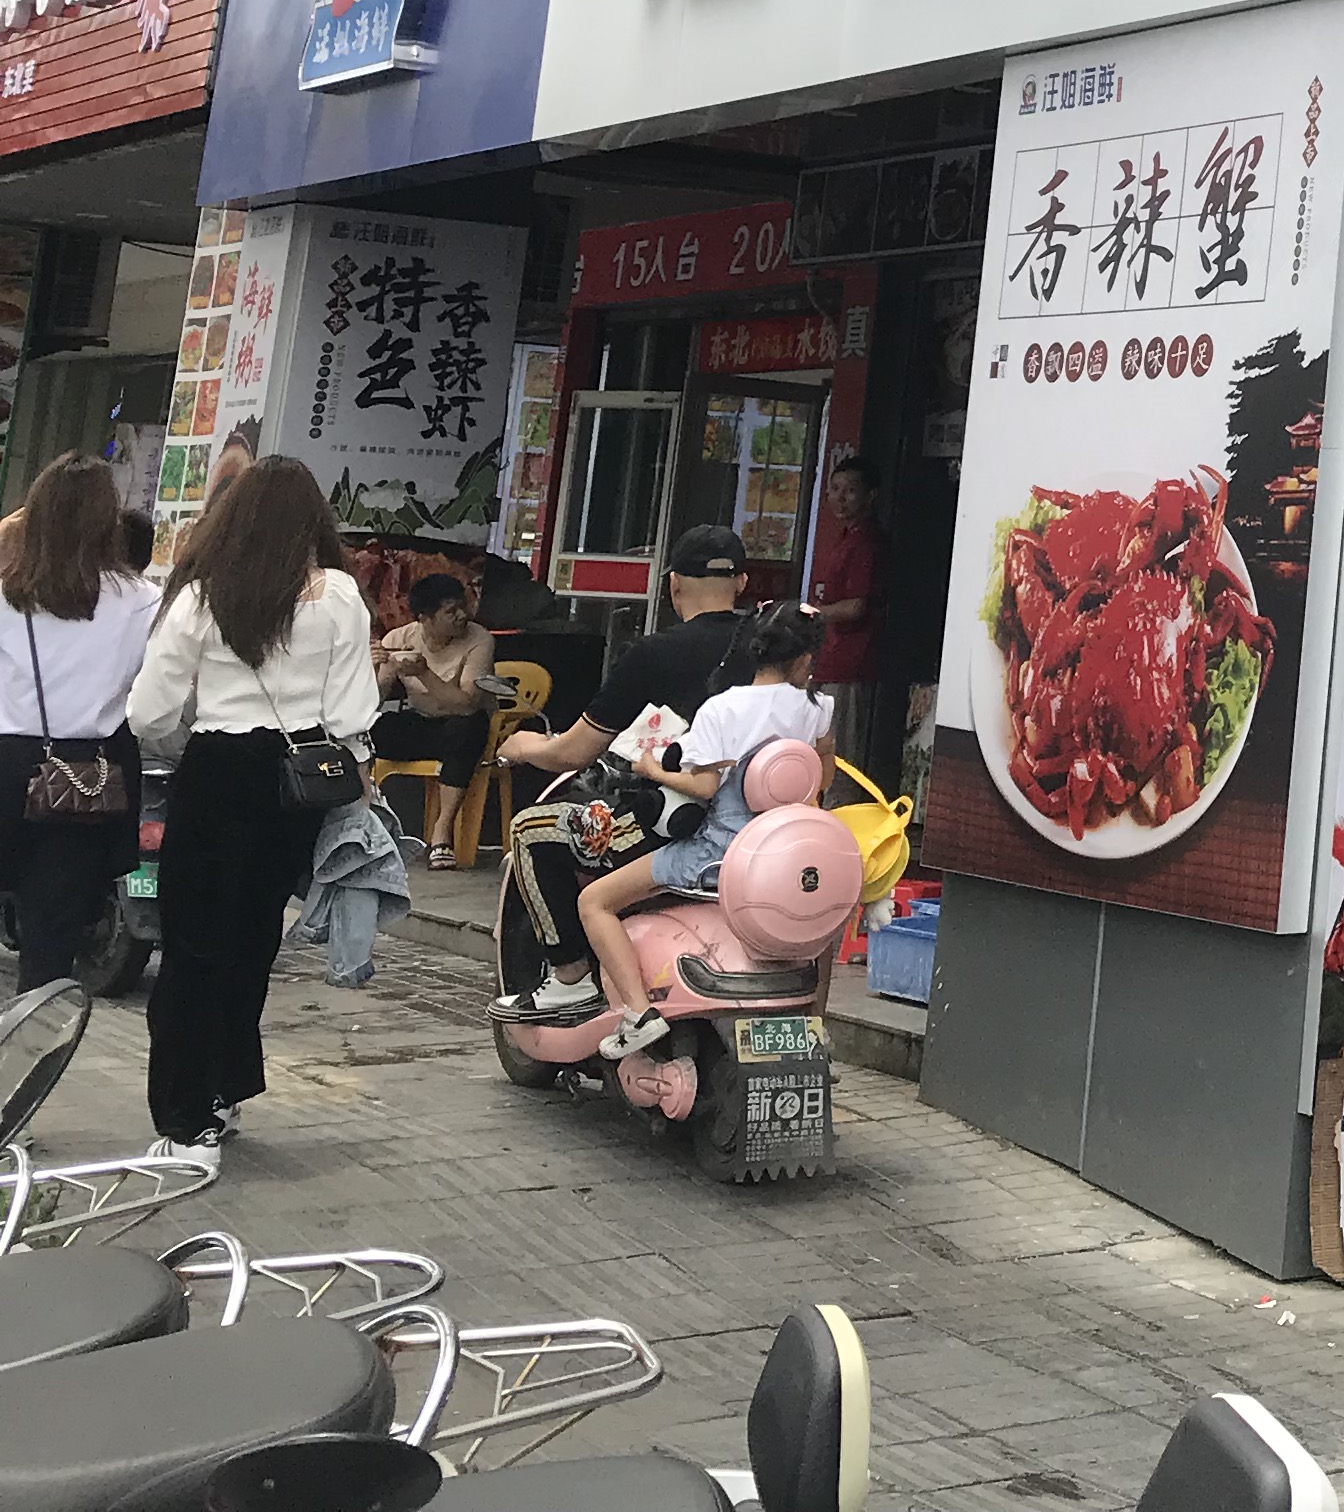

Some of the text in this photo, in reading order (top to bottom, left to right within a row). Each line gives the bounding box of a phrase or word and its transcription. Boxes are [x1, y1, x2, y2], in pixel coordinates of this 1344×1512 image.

[1041, 62, 1117, 113] 汪姐海鲜
[1008, 126, 1265, 302] 香辣蟹
[613, 231, 701, 289] 15人台
[355, 255, 443, 410] 特色
[421, 279, 492, 442] 香辣虾
[1024, 343, 1107, 380] 香飘四溢
[1122, 341, 1211, 377] 辣味十足
[754, 1033, 806, 1051] BF986
